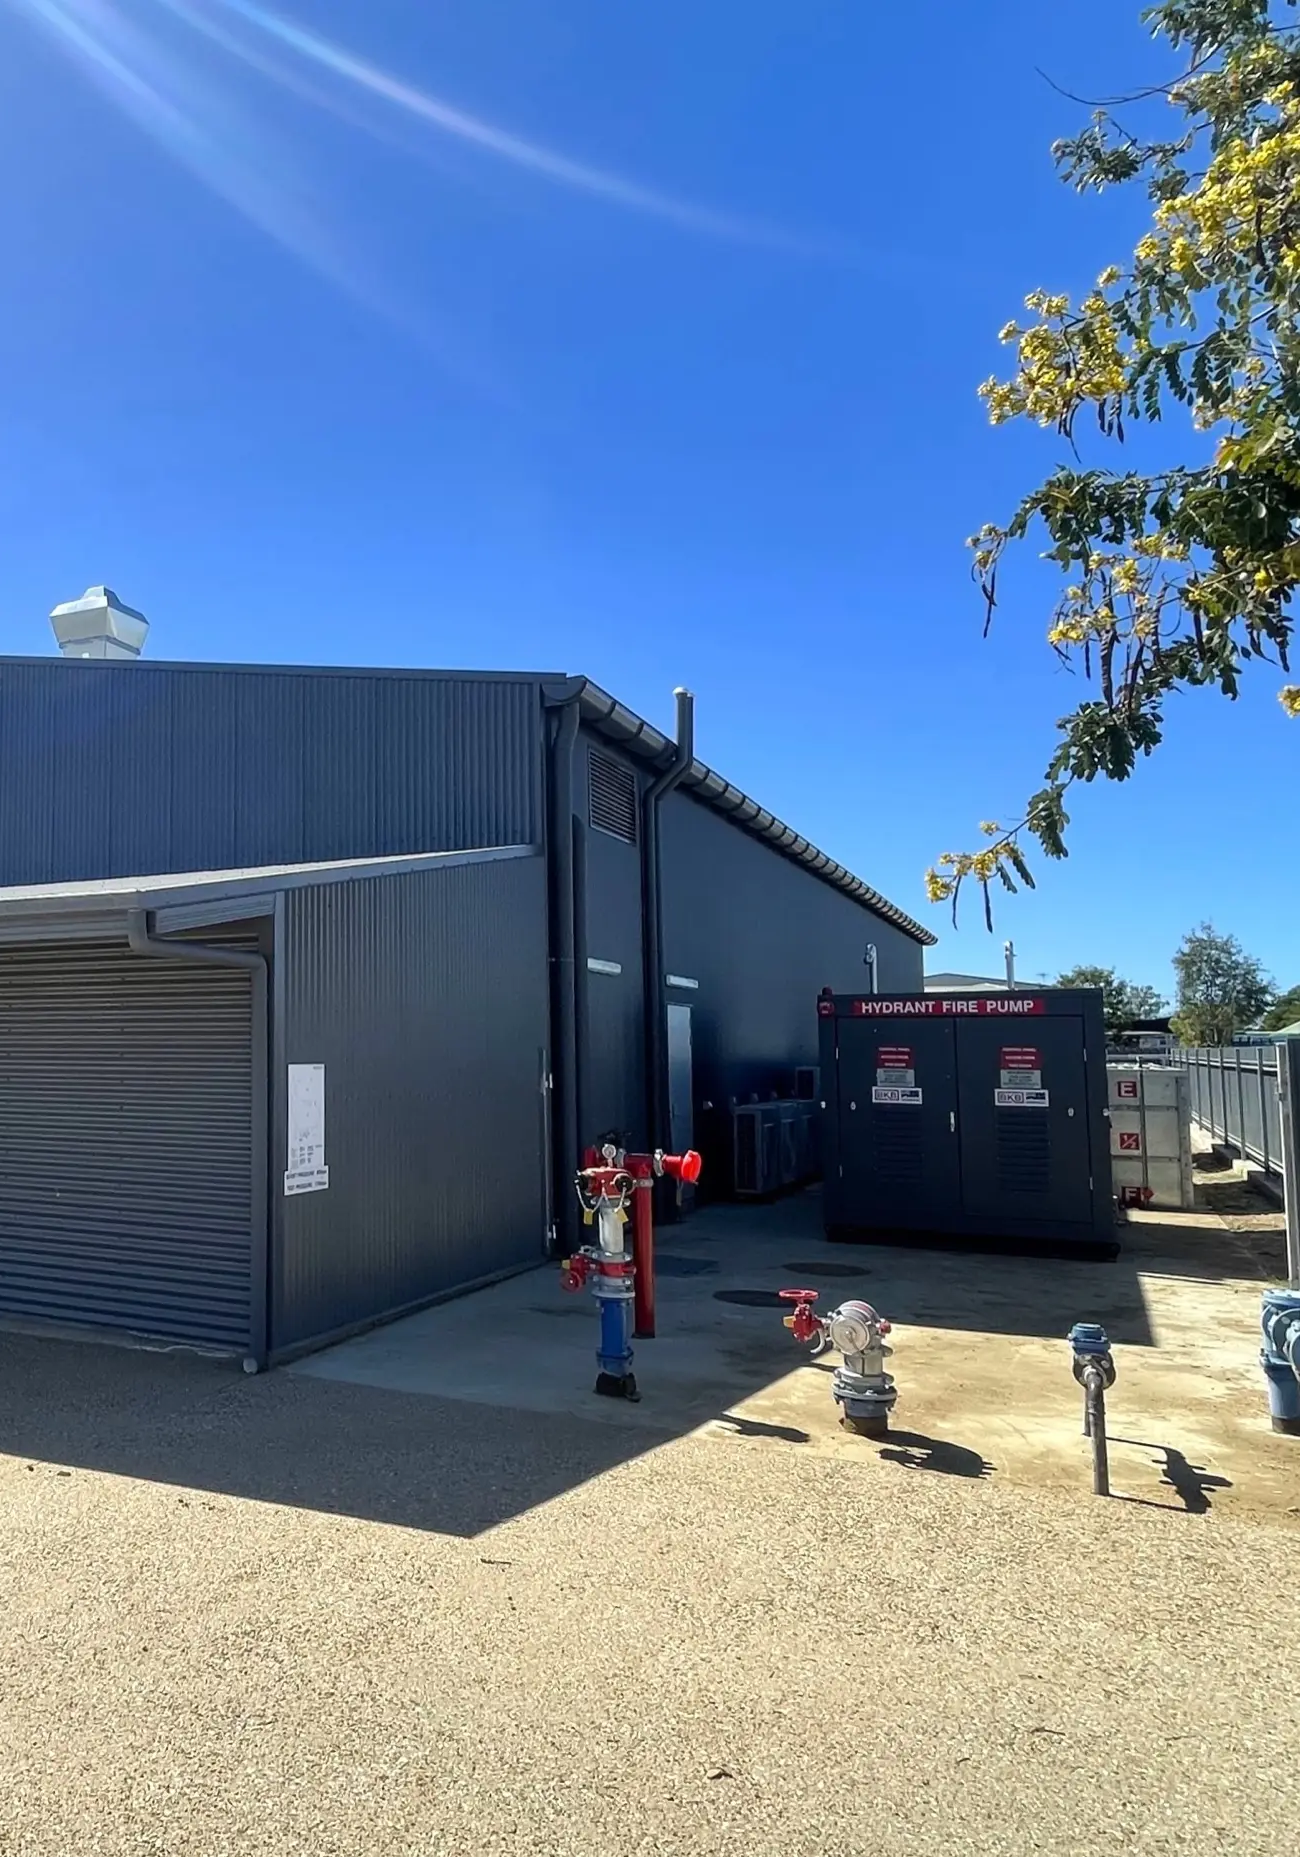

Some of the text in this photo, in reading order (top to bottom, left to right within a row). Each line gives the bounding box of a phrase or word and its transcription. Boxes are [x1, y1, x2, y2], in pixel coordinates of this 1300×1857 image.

[861, 1000, 1034, 1014] HYDRANT FIRE PUMP
[1120, 1082, 1134, 1096] E
